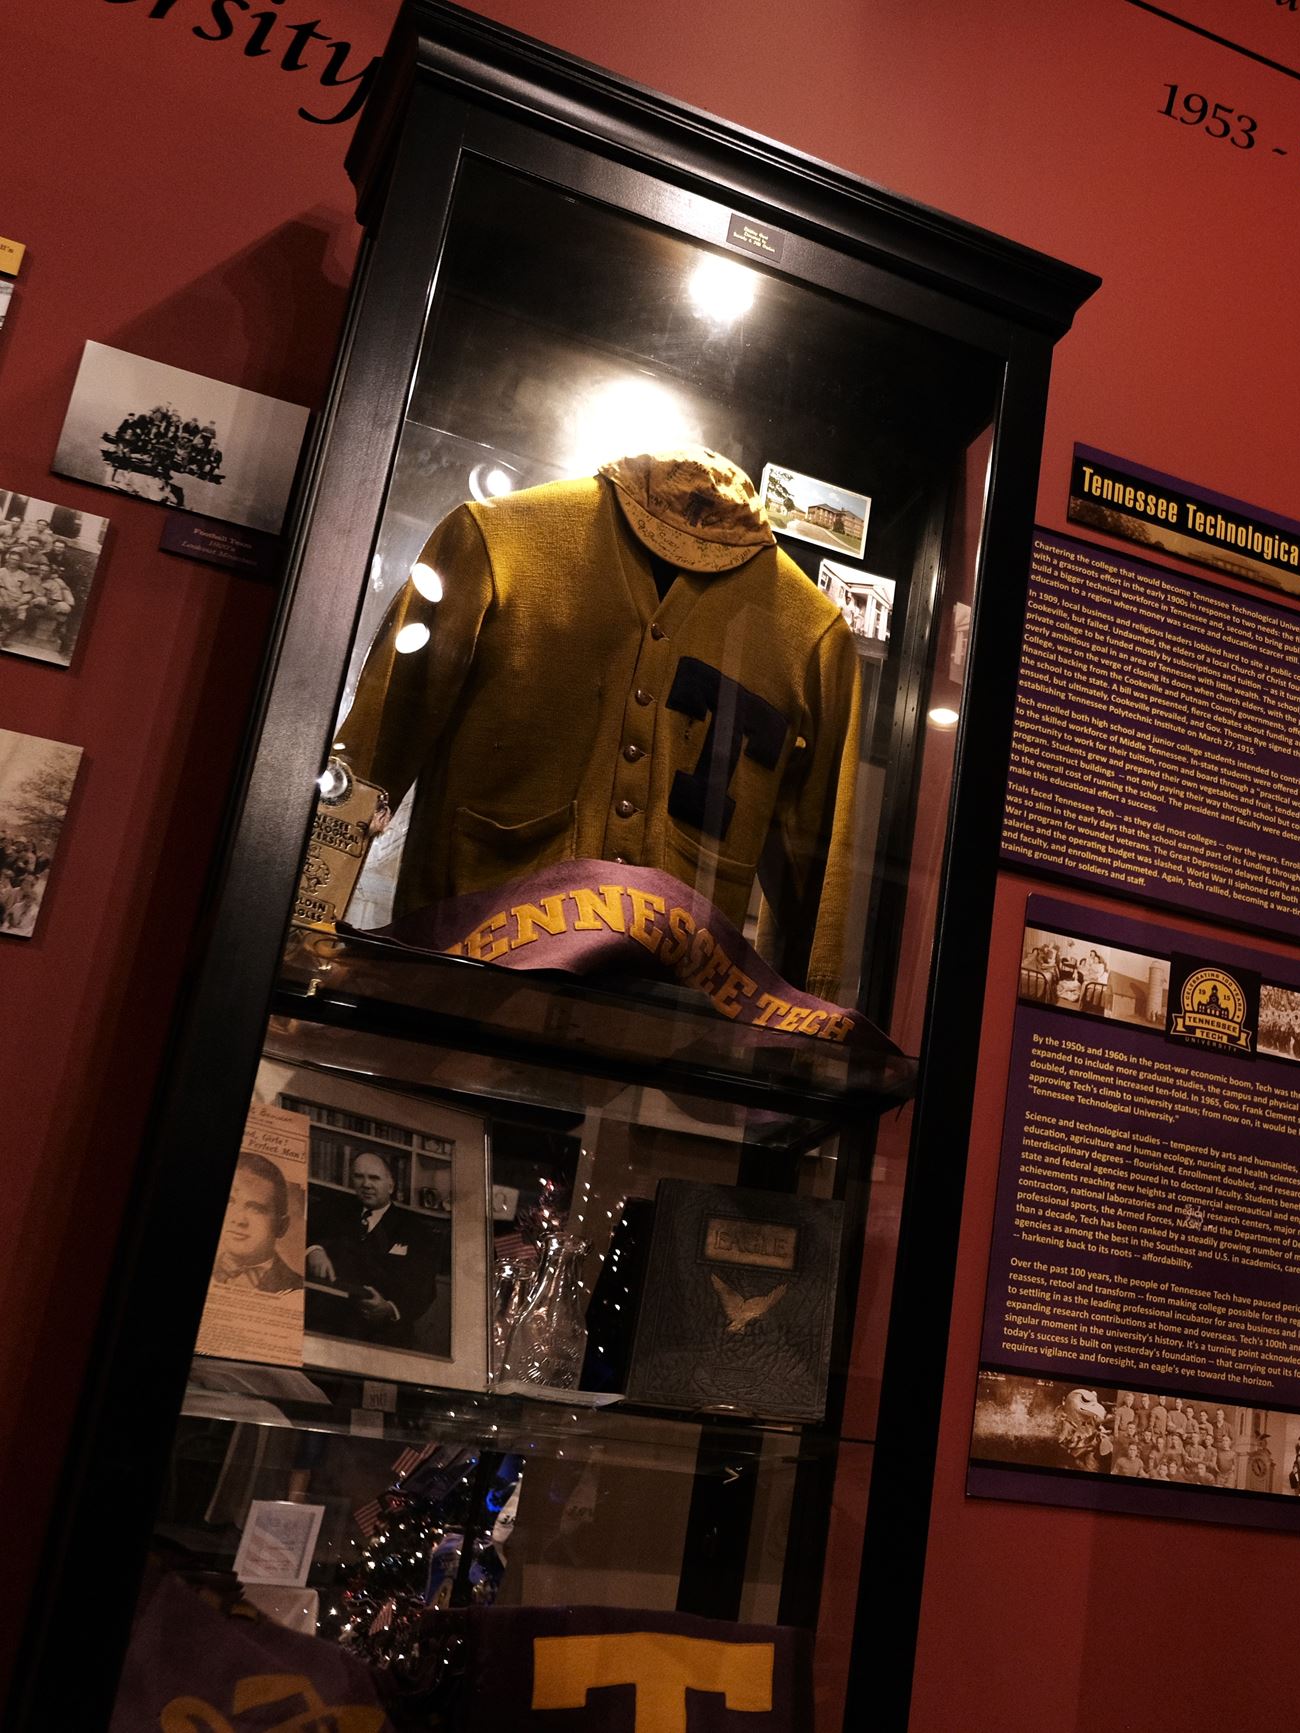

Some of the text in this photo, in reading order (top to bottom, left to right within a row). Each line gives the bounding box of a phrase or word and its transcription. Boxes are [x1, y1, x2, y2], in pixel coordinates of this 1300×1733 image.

[1157, 83, 1258, 150] 1953
[1083, 466, 1178, 524] Tennessee
[1034, 540, 1076, 561] Chartering
[1076, 554, 1090, 565] the
[1090, 559, 1119, 574] college
[1119, 568, 1136, 580] that
[1136, 574, 1161, 587] would
[1161, 580, 1192, 597] become
[1192, 591, 1230, 610] Tennessee
[1231, 603, 1279, 626] Technological
[1018, 679, 1257, 756] establishing Tennessee Polytechnic Institute on March 27, 1915.
[1001, 840, 1146, 887] training ground for soldiers and staff.
[443, 884, 855, 1042] ENNESSEE TECH
[1185, 972, 1220, 1000] CELEBRATING
[1233, 987, 1242, 1012] YEARS
[1185, 1037, 1237, 1052] UNIVERSITY
[1187, 1016, 1238, 1033] TENNESSEE
[1200, 1030, 1224, 1041] TECH
[1032, 1033, 1044, 1045] By
[1045, 1036, 1060, 1047] the
[1060, 1039, 1086, 1053] 1950s
[1086, 1047, 1103, 1057] and
[1104, 1049, 1128, 1062] 1960s
[1129, 1054, 1138, 1064] in
[1138, 1057, 1153, 1068] the
[1153, 1061, 1190, 1075] post-war
[1190, 1069, 1228, 1084] economic
[1228, 1076, 1254, 1090] boom,
[1255, 1082, 1273, 1093] Tech
[1273, 1087, 1289, 1097] was
[1027, 1084, 1180, 1124] "Tennessee Technological University."
[1024, 1110, 1057, 1125] Science
[1057, 1118, 1075, 1129] and
[1075, 1121, 1131, 1139] technological
[1131, 1133, 1161, 1146] studies
[1169, 1140, 1209, 1155] tempered
[1209, 1147, 1221, 1159] by
[1221, 1151, 1237, 1161] arts
[1237, 1154, 1253, 1164] and
[1253, 1156, 1299, 1174] humanities,
[1010, 1257, 1032, 1269] Over
[1033, 1260, 1049, 1272] the
[1049, 1265, 1069, 1275] past
[1069, 1266, 1087, 1278] 100
[1087, 1271, 1112, 1284] years,
[1114, 1274, 1129, 1285] the
[1129, 1278, 1159, 1290] people
[1159, 1282, 1170, 1291] of
[1170, 1283, 1212, 1298] Tennessee
[1213, 1290, 1231, 1301] Tech
[1232, 1293, 1252, 1305] have
[1252, 1299, 1281, 1310] paused
[1001, 1341, 1274, 1388] requires vigilance and foresight, an eagle's eye toward the horizon.
